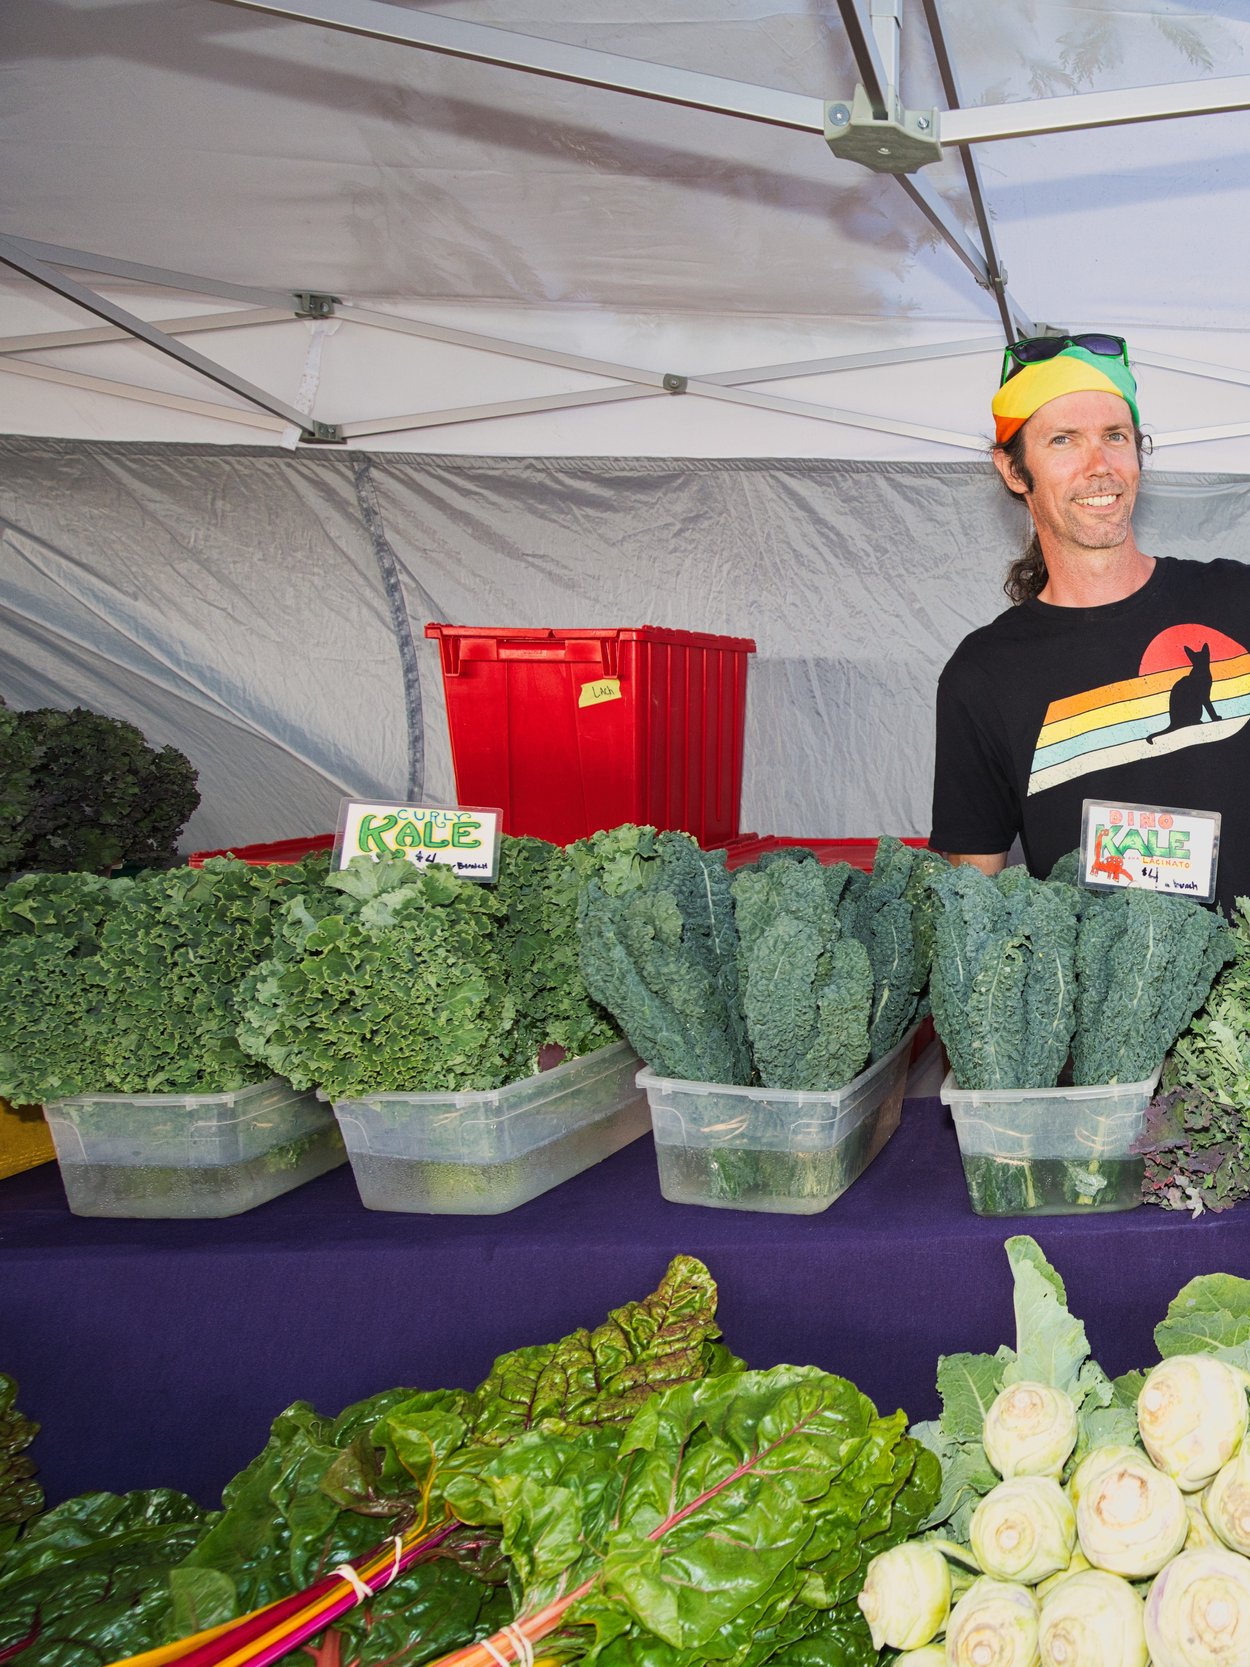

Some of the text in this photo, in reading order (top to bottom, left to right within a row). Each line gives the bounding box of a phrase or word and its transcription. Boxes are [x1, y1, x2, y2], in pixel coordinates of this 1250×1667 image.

[397, 808, 472, 829] CURLY
[1109, 809, 1174, 830] DINO
[358, 814, 482, 859] KALE
[1095, 823, 1191, 860] KALE
[415, 850, 437, 863] $4
[1142, 856, 1191, 869] LACINATO
[1141, 866, 1159, 884] $4
